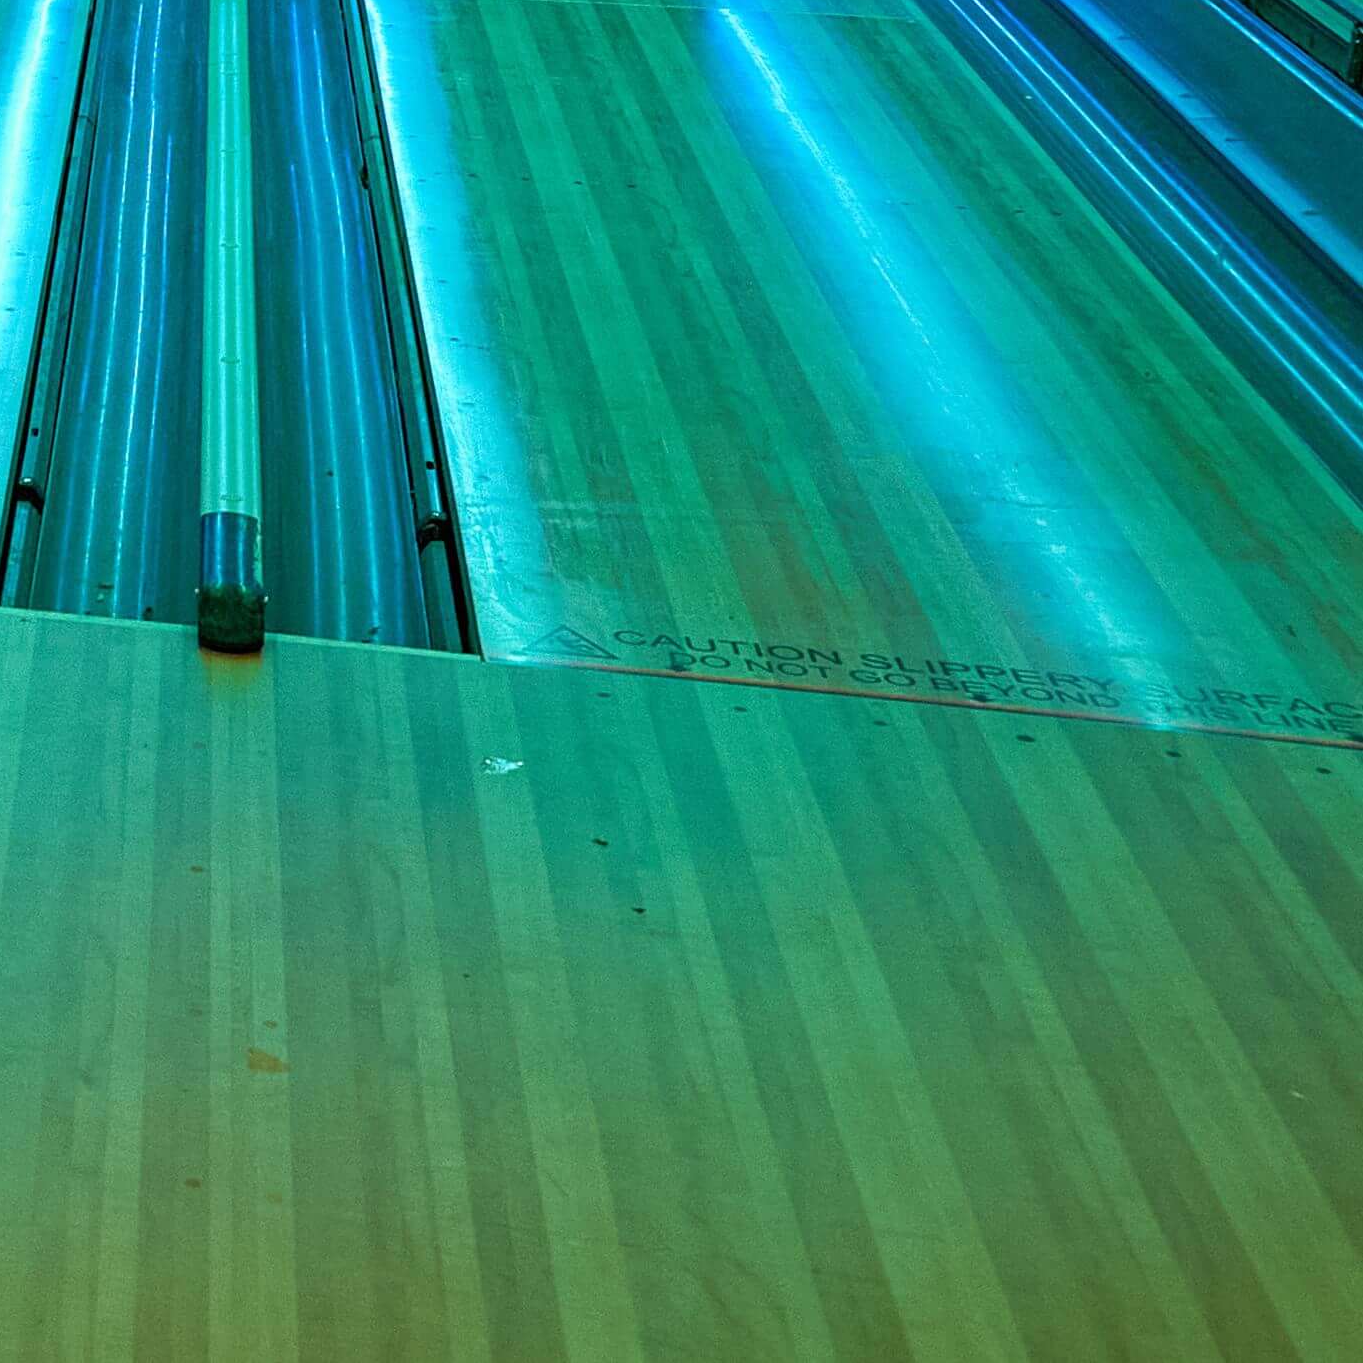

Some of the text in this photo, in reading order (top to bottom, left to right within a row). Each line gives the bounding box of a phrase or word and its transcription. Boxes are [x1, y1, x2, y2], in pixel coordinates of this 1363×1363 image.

[613, 630, 1363, 719] CAUTION SLIPPERY SURFAC
[670, 652, 731, 669] DO
[745, 658, 832, 678] NOT
[850, 669, 916, 687] GO
[933, 678, 1120, 708] BEYOND
[1252, 711, 1354, 734] LINE
